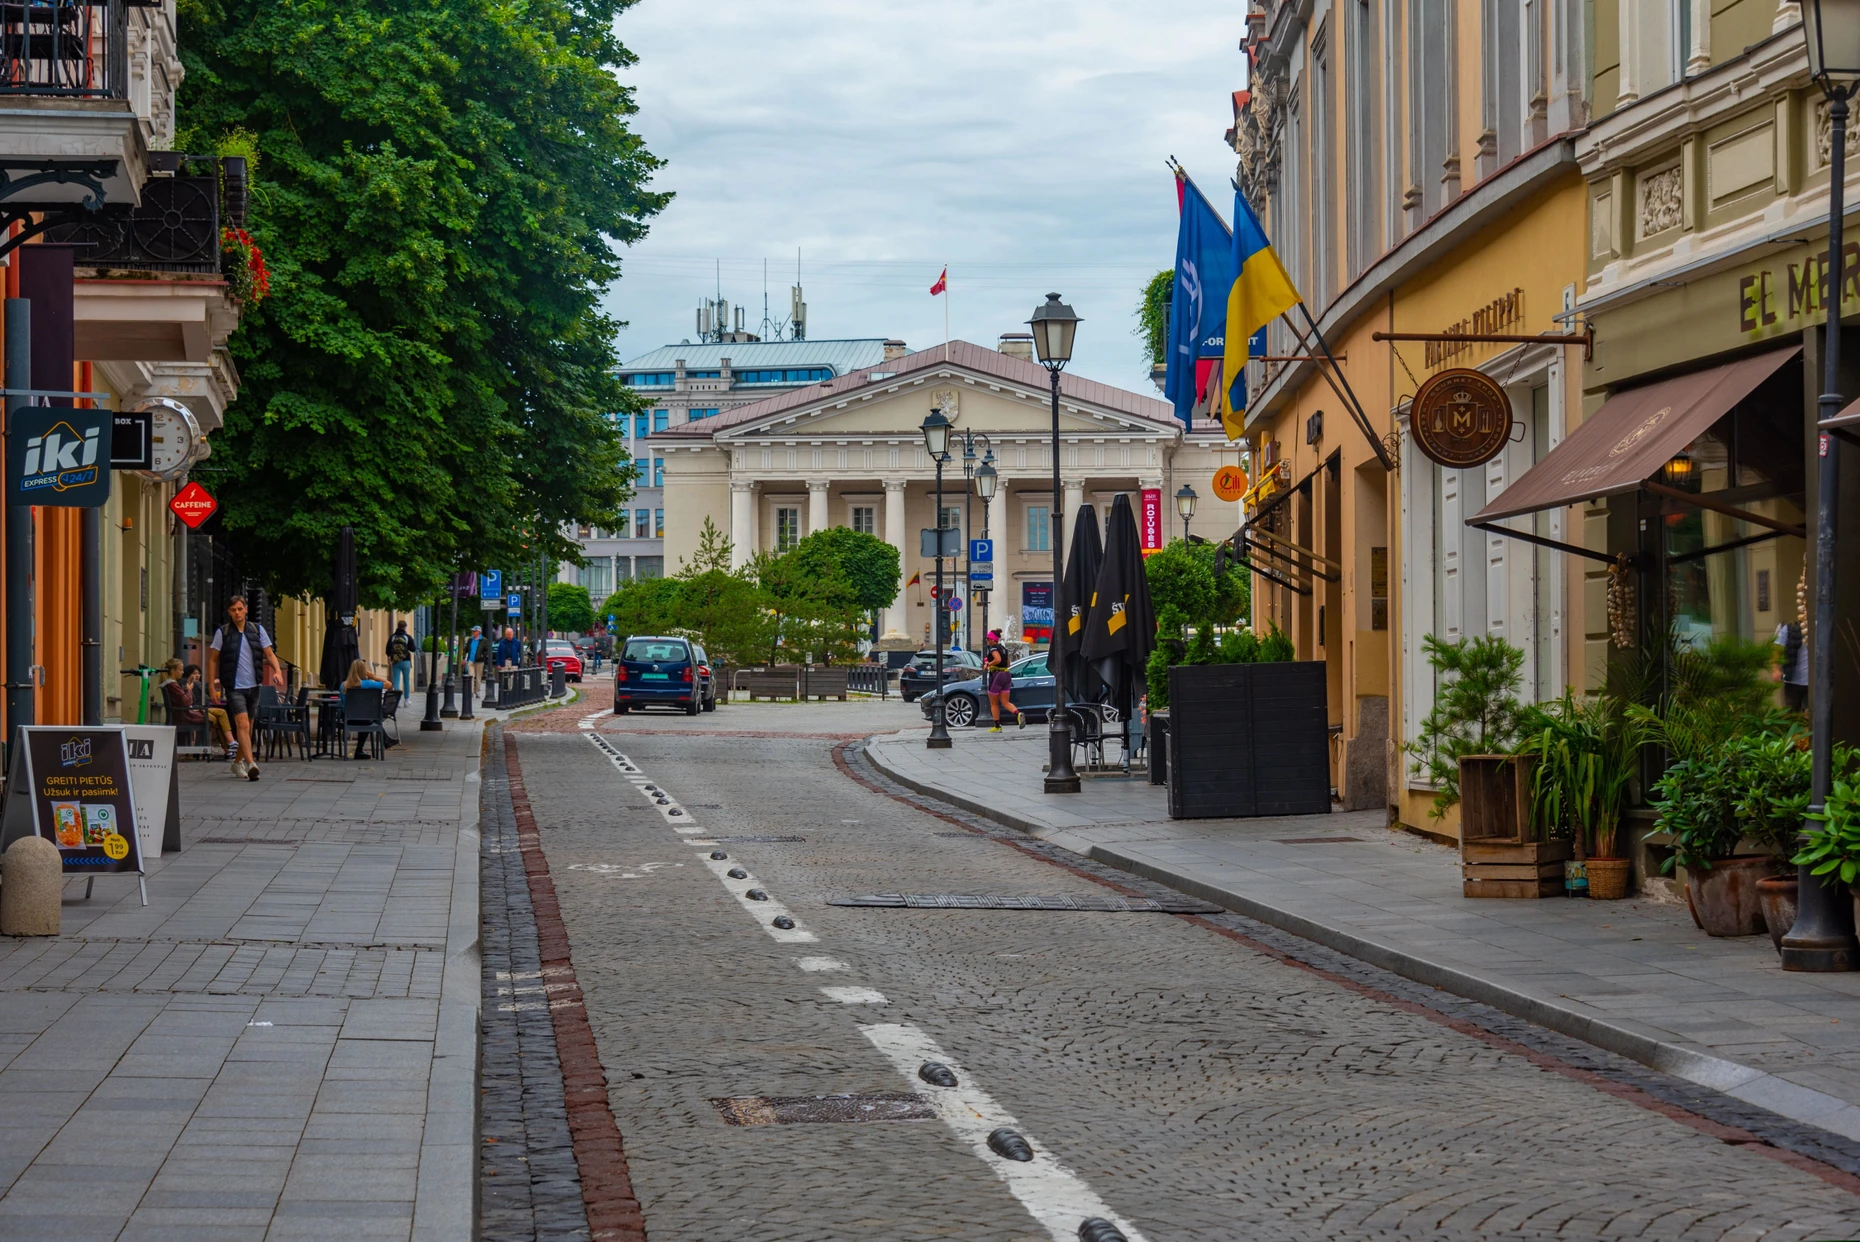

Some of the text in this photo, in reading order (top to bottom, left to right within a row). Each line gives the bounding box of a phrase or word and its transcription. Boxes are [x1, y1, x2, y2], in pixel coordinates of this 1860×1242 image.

[1740, 271, 1776, 332] EL
[1430, 378, 1497, 401] GOURMET SHOP
[1453, 411, 1471, 427] M
[1420, 407, 1454, 458] RESTAURANT
[24, 427, 100, 476] iki
[24, 476, 58, 487] EXPRESS
[976, 542, 988, 560] P
[511, 596, 518, 605] P
[61, 738, 91, 761] iki
[46, 775, 113, 785] GREITI PIETŪS
[43, 787, 119, 797] Užsuk ir pasiimk!
